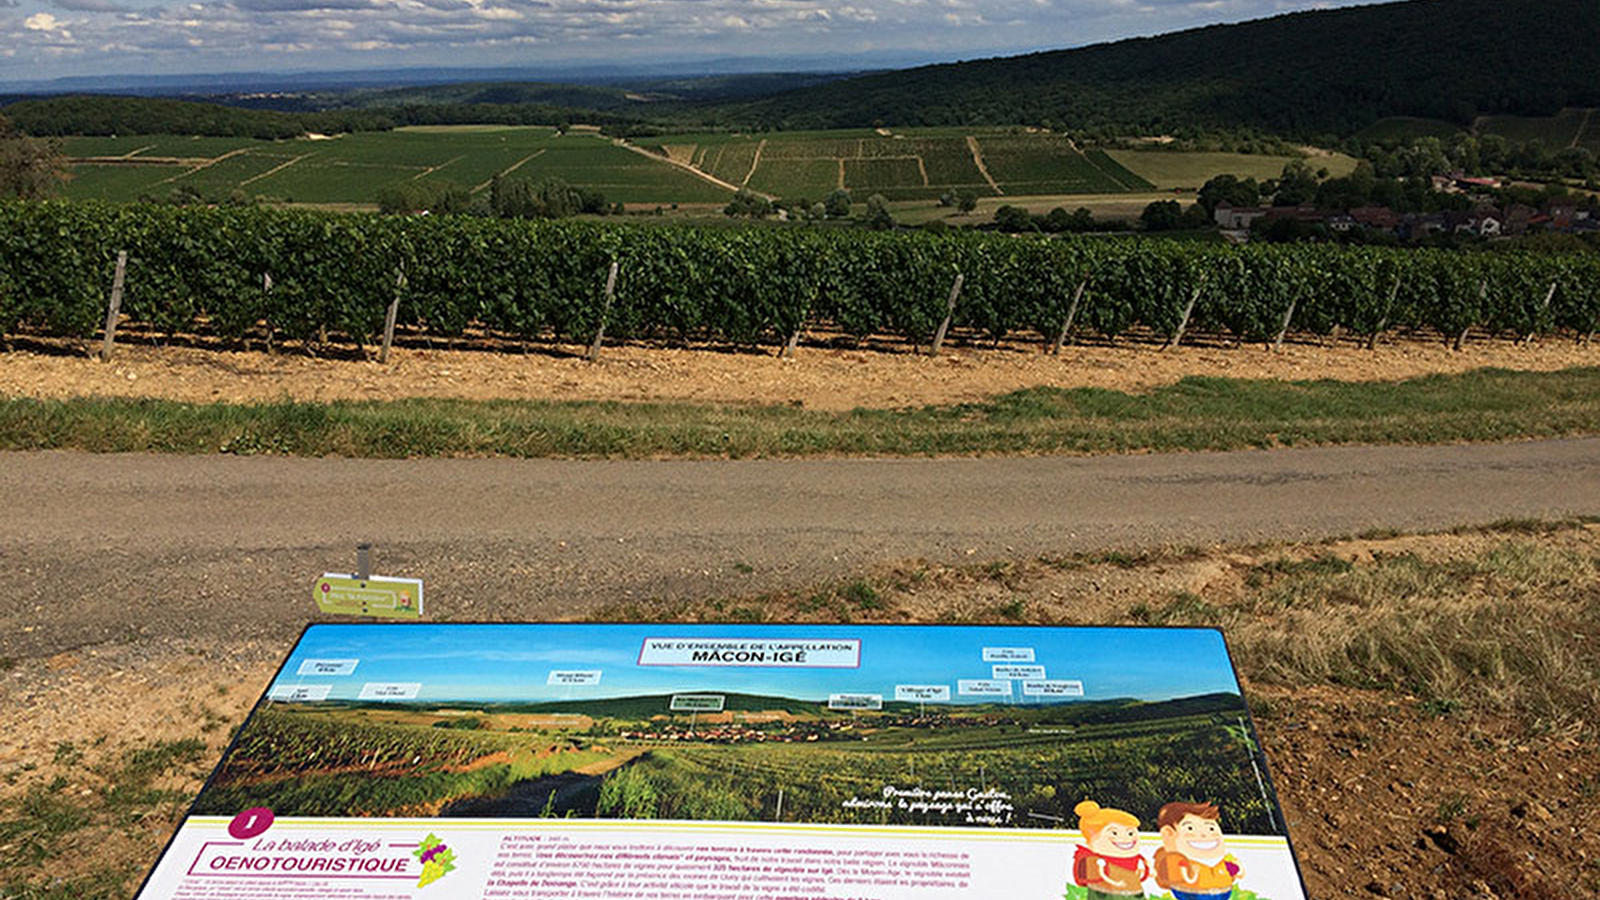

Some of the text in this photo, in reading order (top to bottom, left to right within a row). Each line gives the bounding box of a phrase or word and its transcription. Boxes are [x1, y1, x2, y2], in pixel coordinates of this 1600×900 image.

[651, 642, 675, 650] VUE
[676, 642, 749, 650] D'ENSEMBLE
[768, 643, 853, 651] L'APPELLATION
[692, 650, 807, 663] MÂCON-IGÉ
[909, 802, 954, 813] paysage
[955, 801, 974, 813] qui
[245, 815, 258, 829] 1
[966, 812, 974, 823] à
[253, 838, 382, 855] La balade d'Igé
[209, 856, 410, 872] OENOTOURISTIQUE
